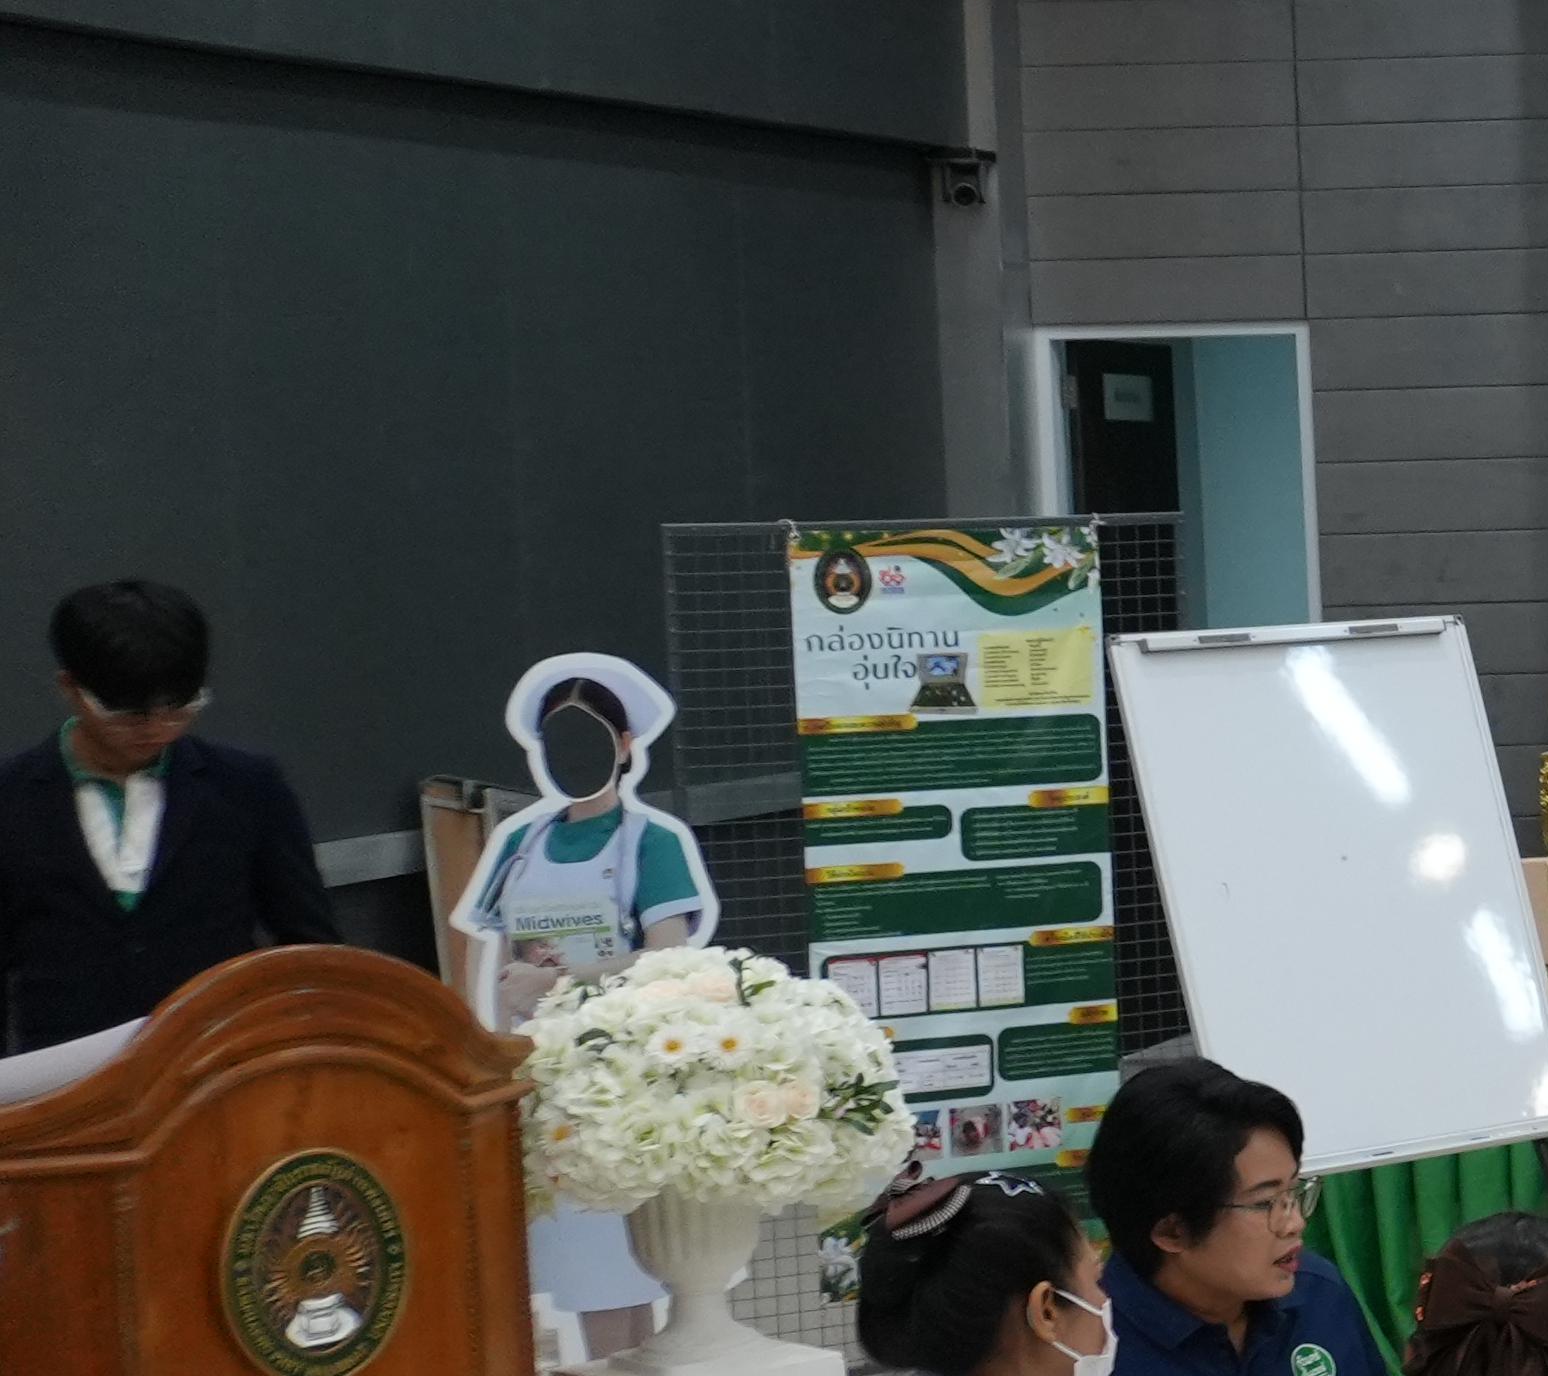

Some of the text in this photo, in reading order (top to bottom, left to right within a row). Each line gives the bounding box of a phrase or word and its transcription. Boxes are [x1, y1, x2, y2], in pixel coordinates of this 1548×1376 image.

[803, 625, 961, 652] กล่องนิทาน
[852, 655, 918, 691] อุ่นใจ
[515, 914, 604, 932] Midwives
